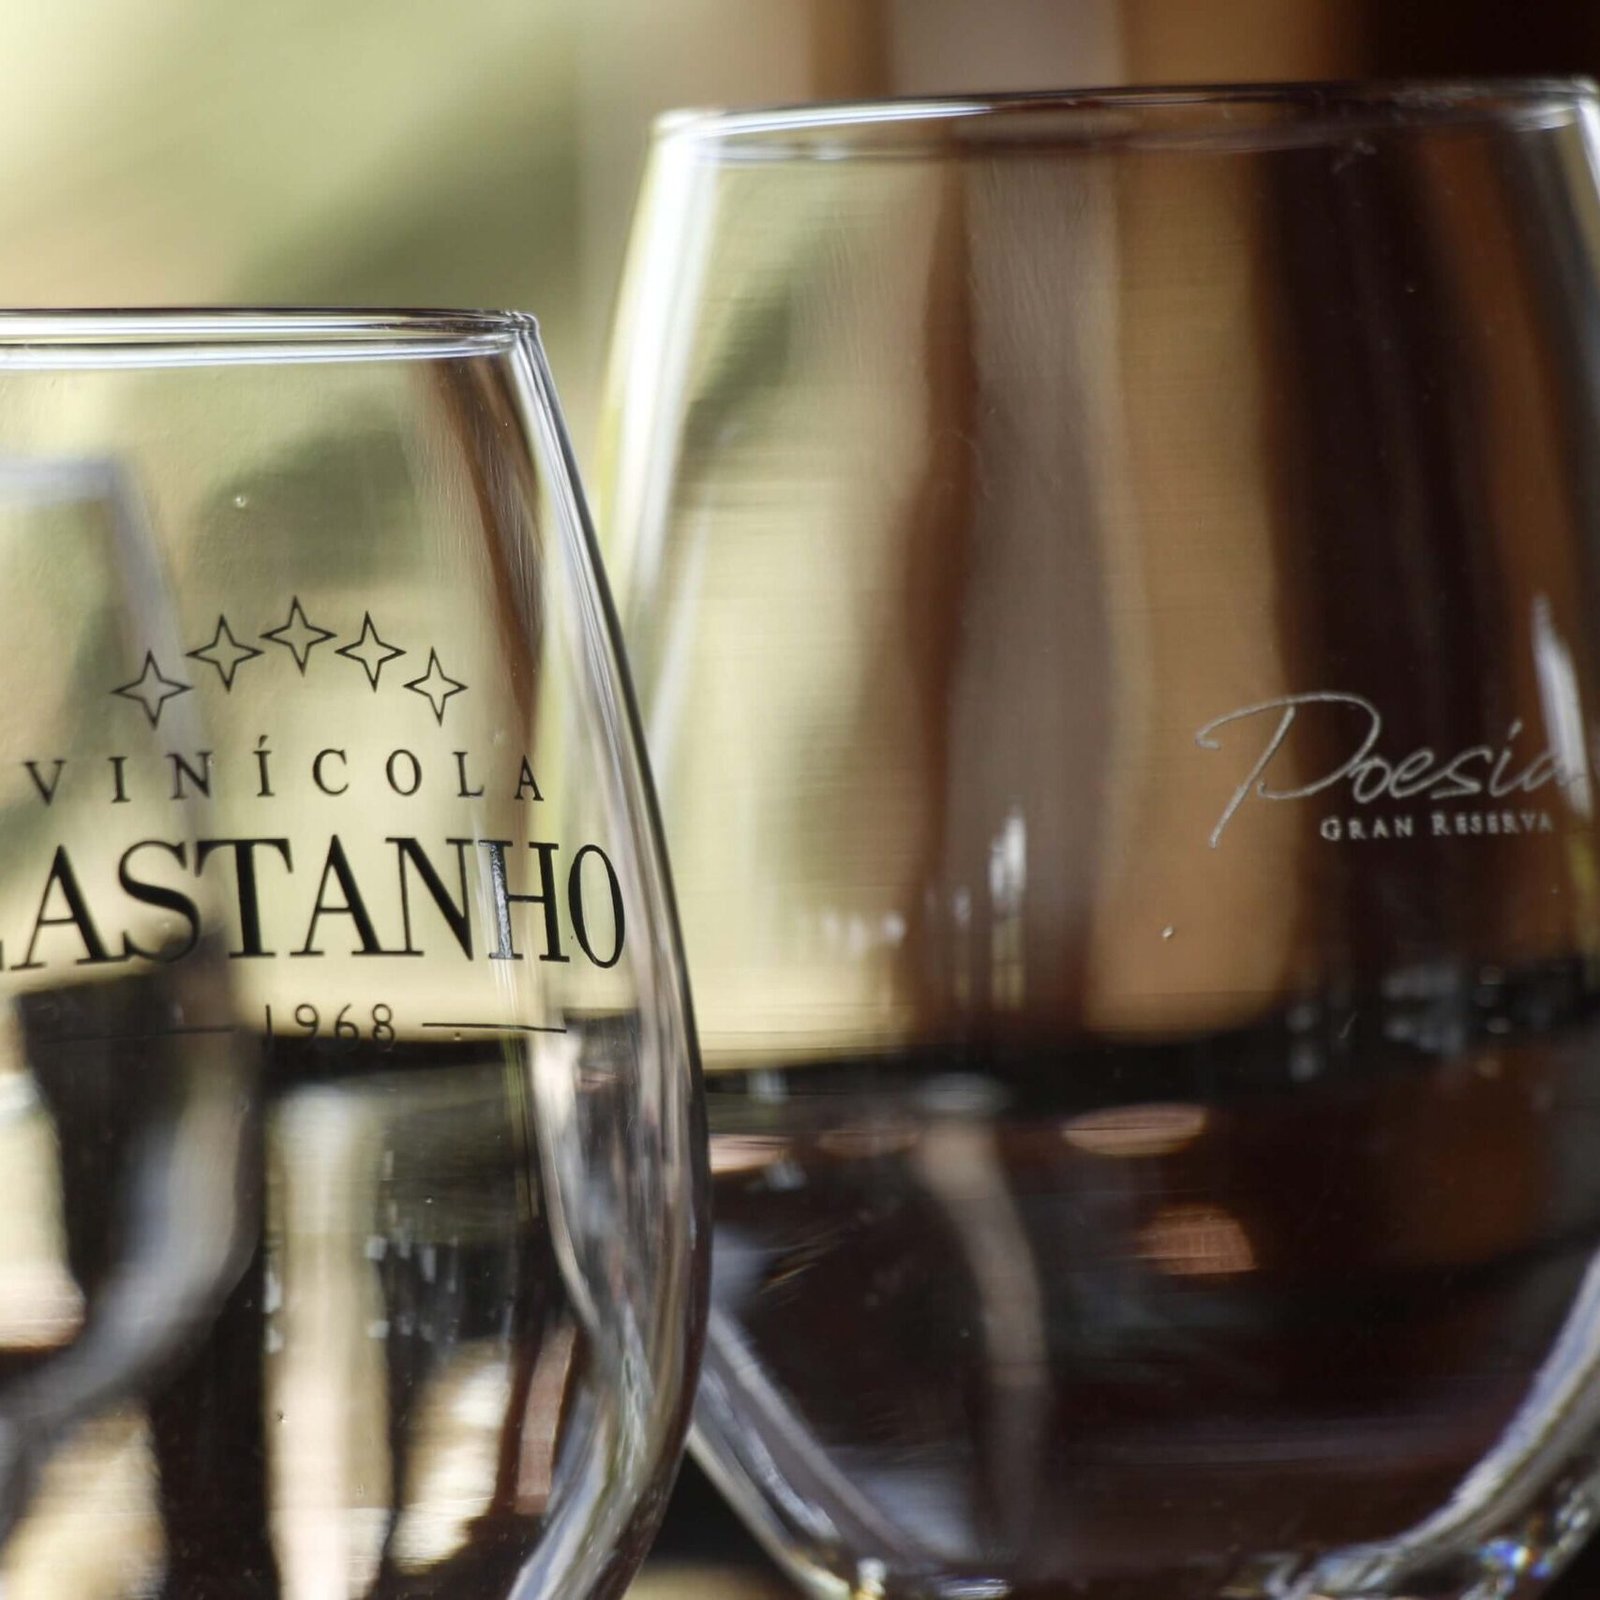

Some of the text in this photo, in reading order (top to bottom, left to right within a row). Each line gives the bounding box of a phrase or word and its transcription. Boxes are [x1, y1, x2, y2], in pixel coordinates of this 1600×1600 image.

[23, 734, 545, 805] VINÍCOLA
[1319, 810, 1555, 843] GRAN RESERVA
[0, 834, 626, 971] ASTANHO
[264, 1003, 397, 1052] 1968
